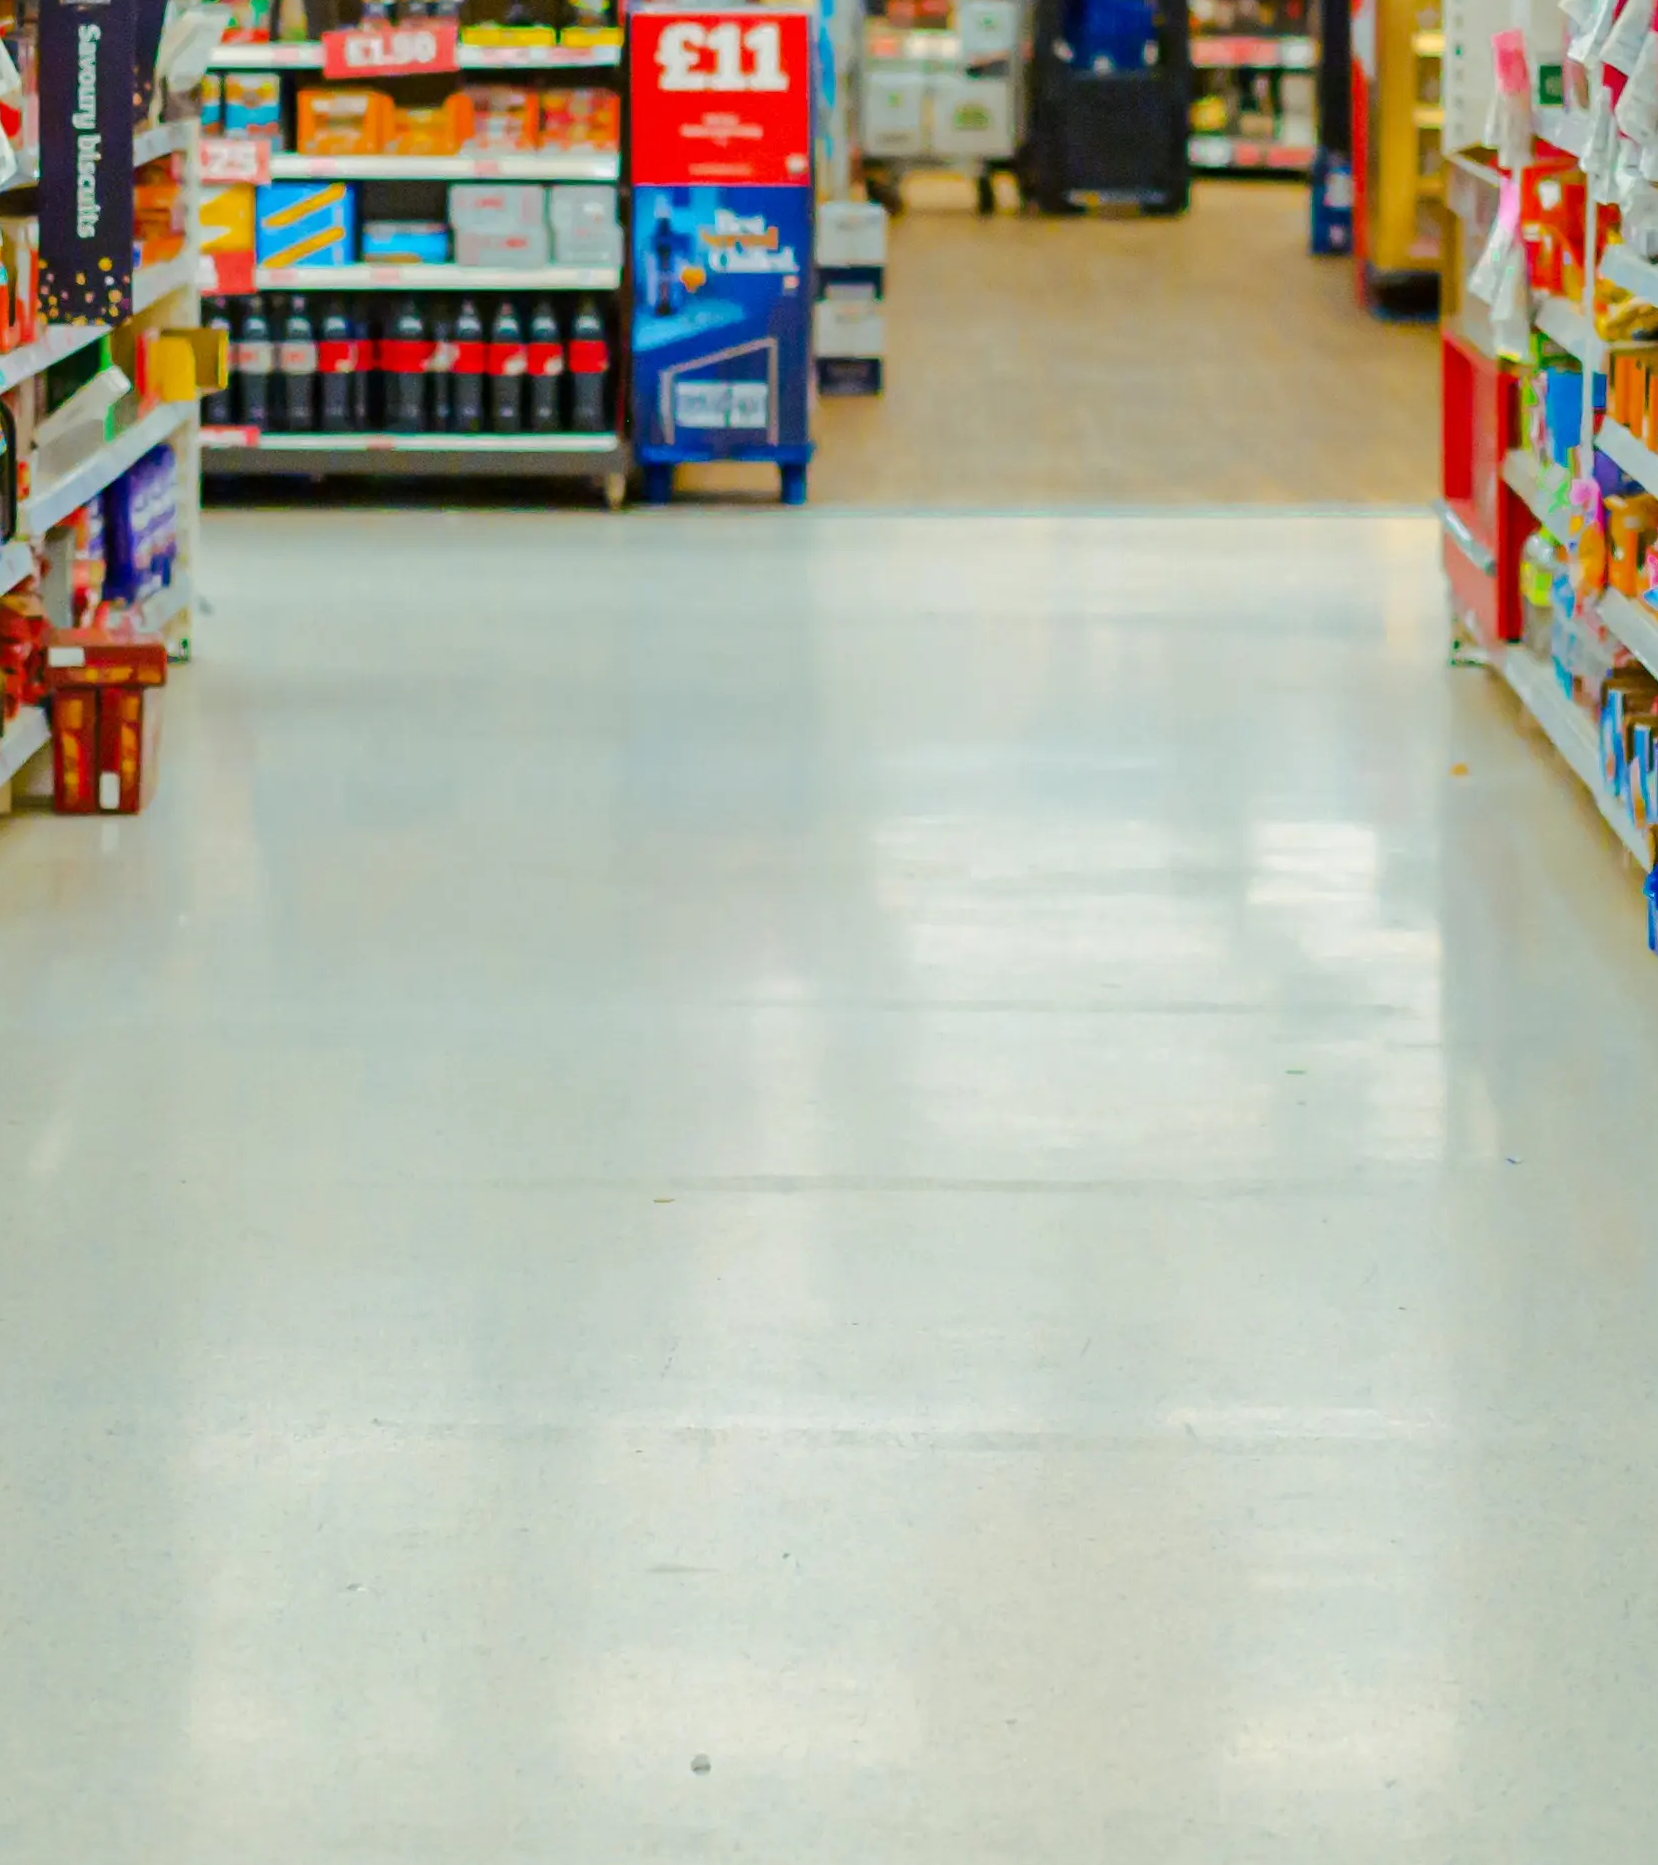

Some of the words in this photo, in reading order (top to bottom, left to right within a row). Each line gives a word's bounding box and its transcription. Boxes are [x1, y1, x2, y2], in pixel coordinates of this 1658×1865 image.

[73, 23, 101, 130] Savoury
[653, 22, 791, 93] £11
[76, 133, 102, 239] biscuits
